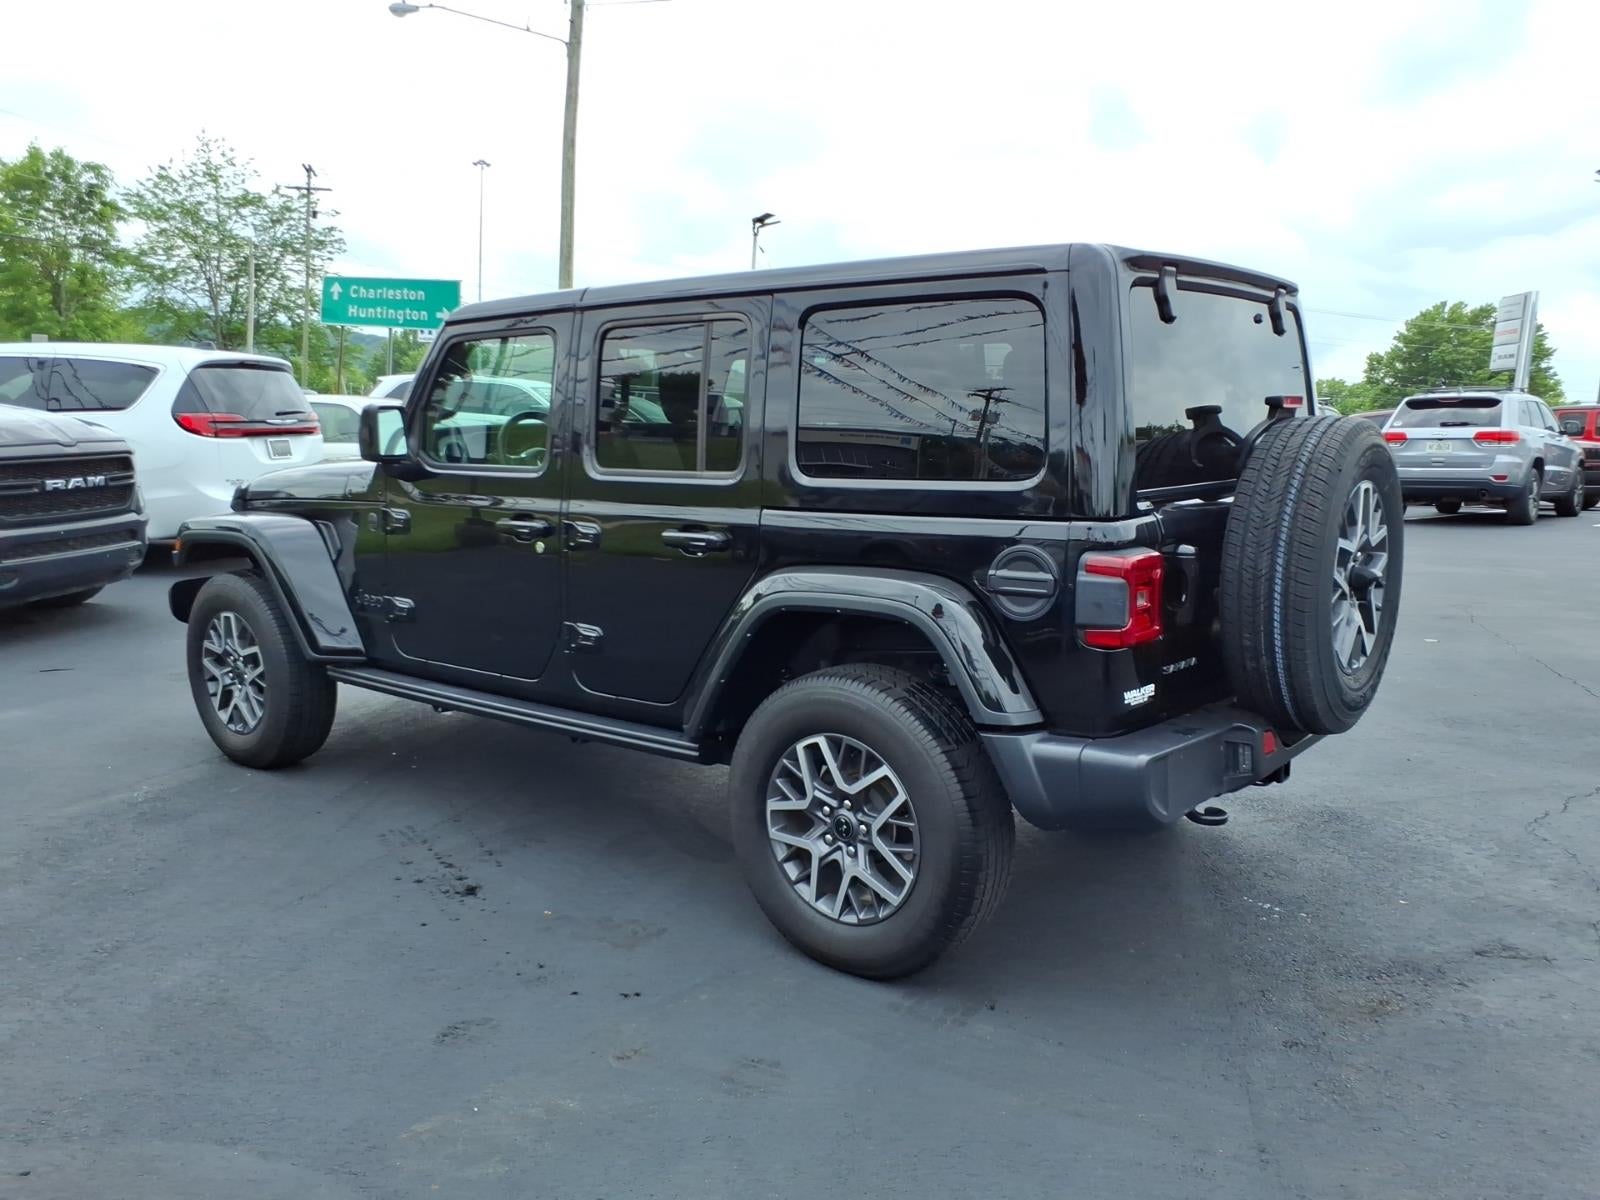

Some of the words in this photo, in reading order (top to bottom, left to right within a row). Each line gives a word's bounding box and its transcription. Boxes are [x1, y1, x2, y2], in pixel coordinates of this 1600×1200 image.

[350, 285, 425, 301] Charleston
[348, 305, 428, 323] Huntington
[45, 475, 105, 491] RAM
[1123, 683, 1155, 700] WALKER
